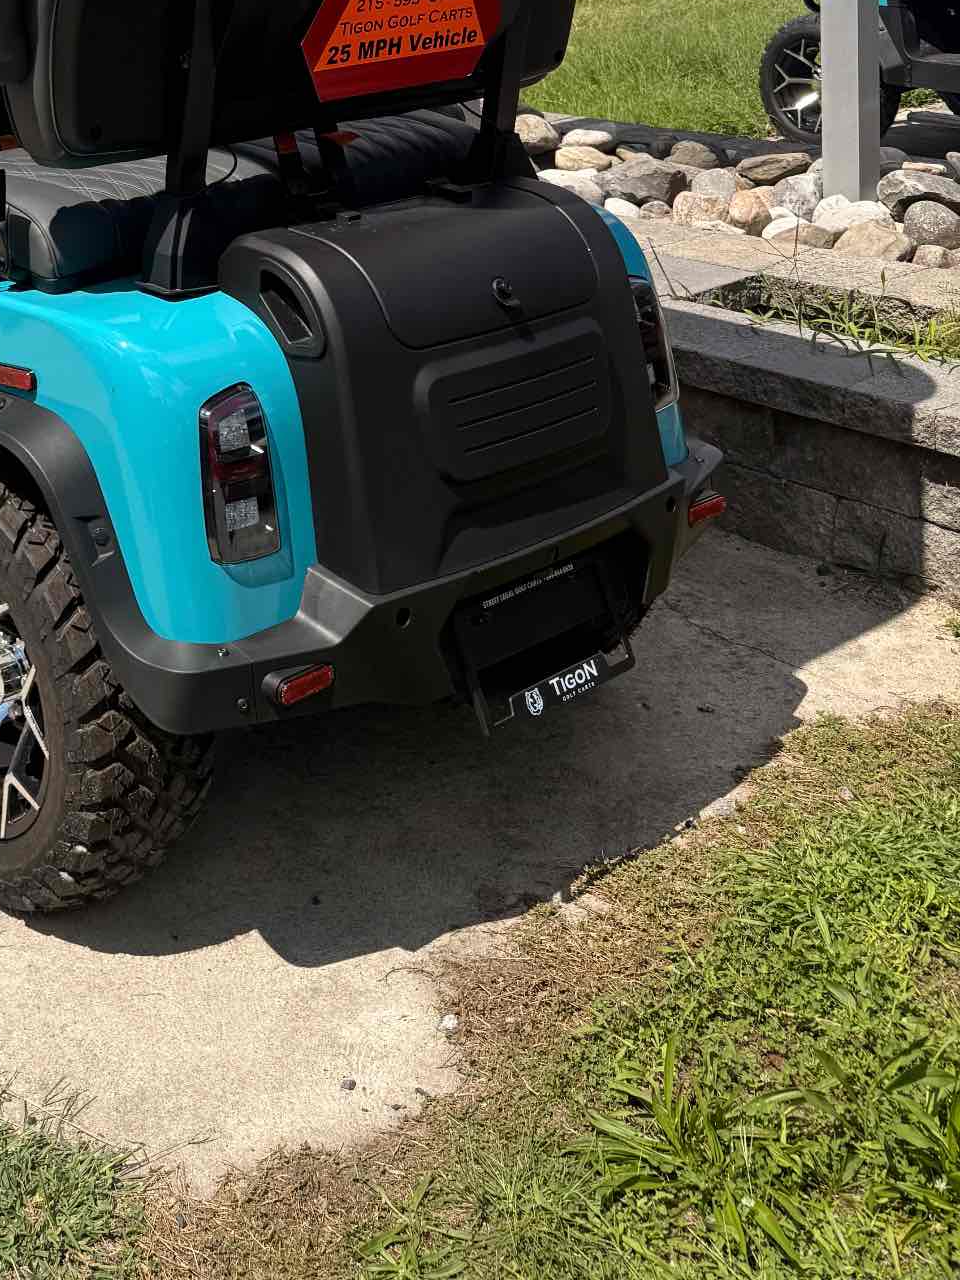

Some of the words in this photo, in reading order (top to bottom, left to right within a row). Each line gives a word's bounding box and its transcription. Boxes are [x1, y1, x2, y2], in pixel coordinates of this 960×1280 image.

[339, 19, 383, 36] TIGON
[388, 13, 425, 29] GOLF
[428, 7, 473, 23] CARTS
[327, 44, 351, 65] 25
[357, 38, 401, 60] MPH
[408, 27, 478, 52] Vehicle
[549, 660, 598, 695] TIGON
